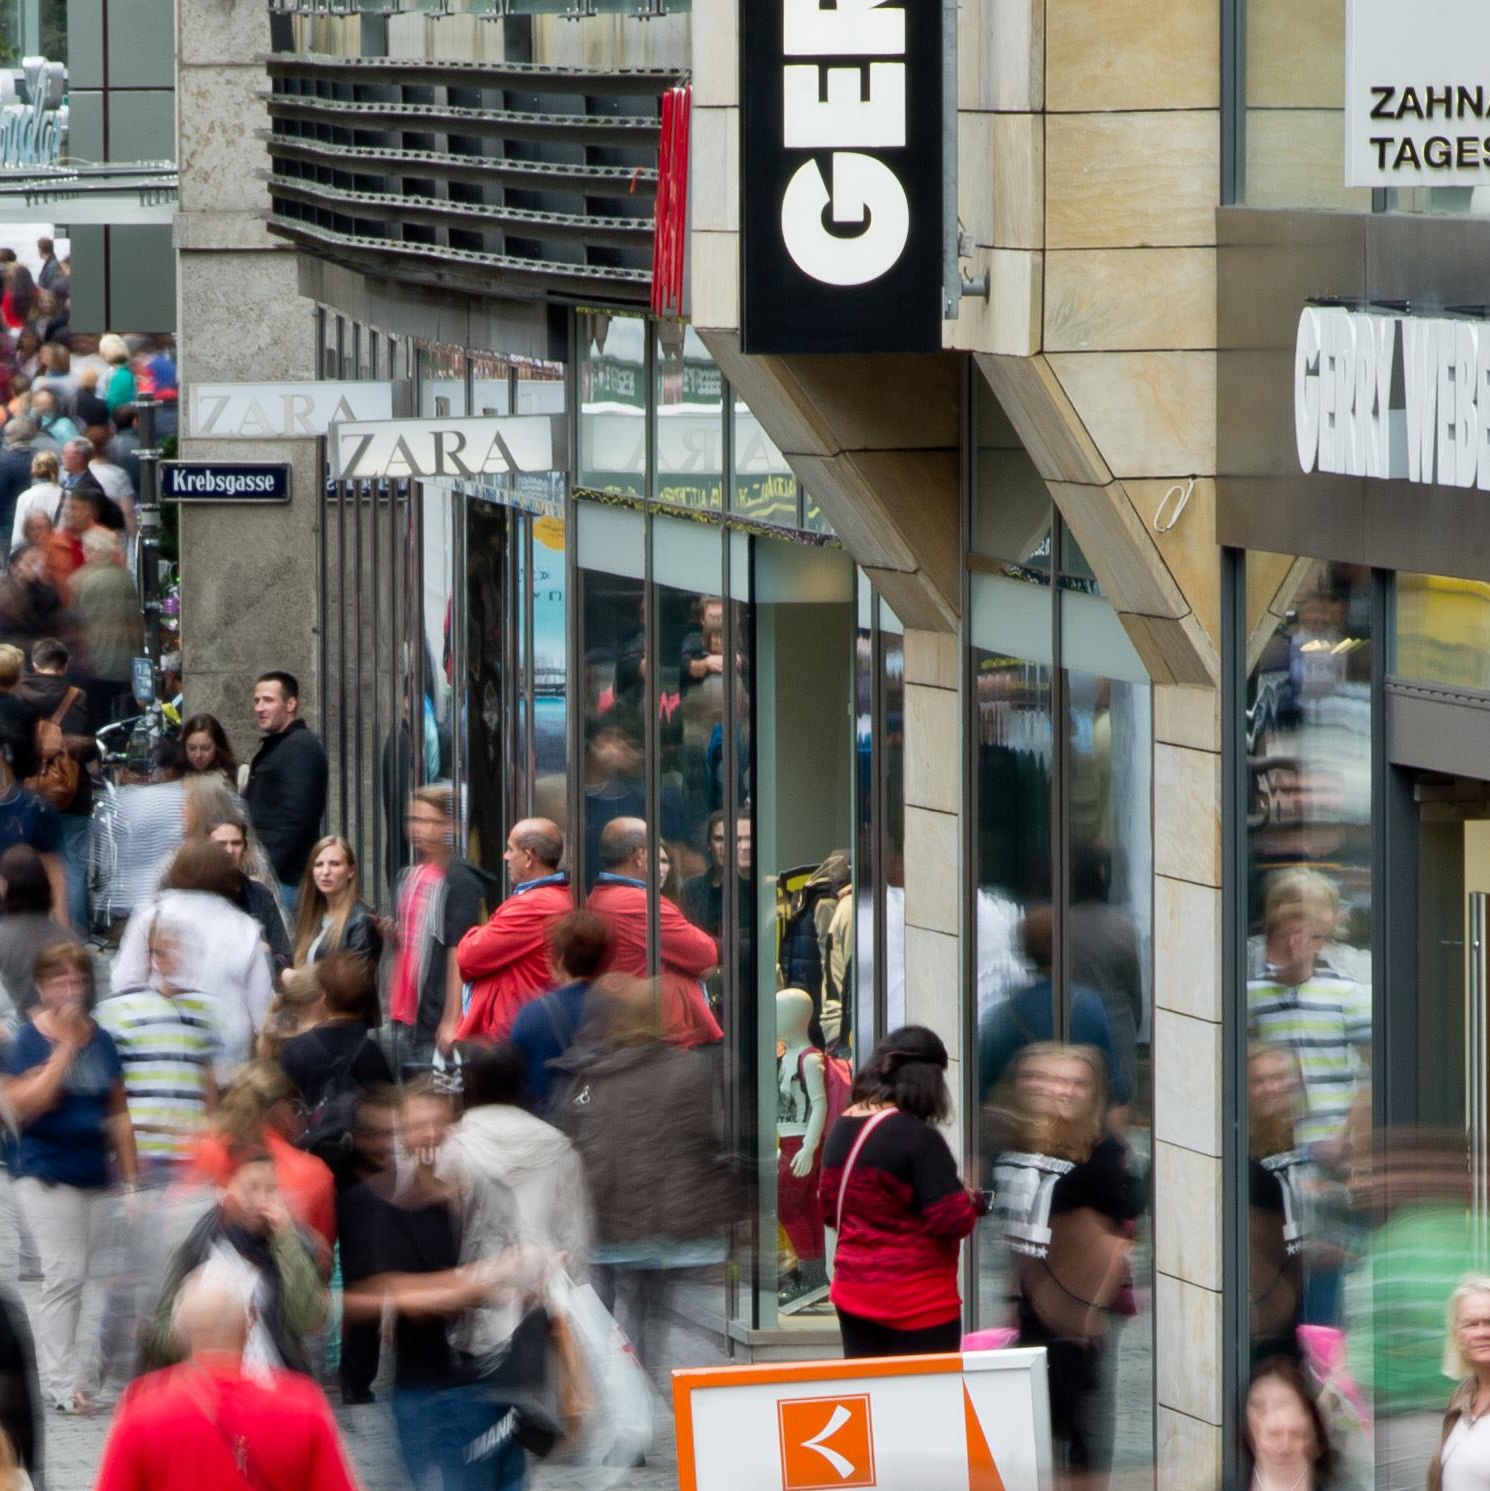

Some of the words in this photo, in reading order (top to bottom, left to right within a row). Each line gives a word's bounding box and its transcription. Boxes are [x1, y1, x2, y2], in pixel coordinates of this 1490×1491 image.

[197, 393, 359, 437] ZARA
[1294, 306, 1397, 480] GERRY
[340, 430, 526, 478] ZARA
[172, 469, 276, 495] Krebsgasse
